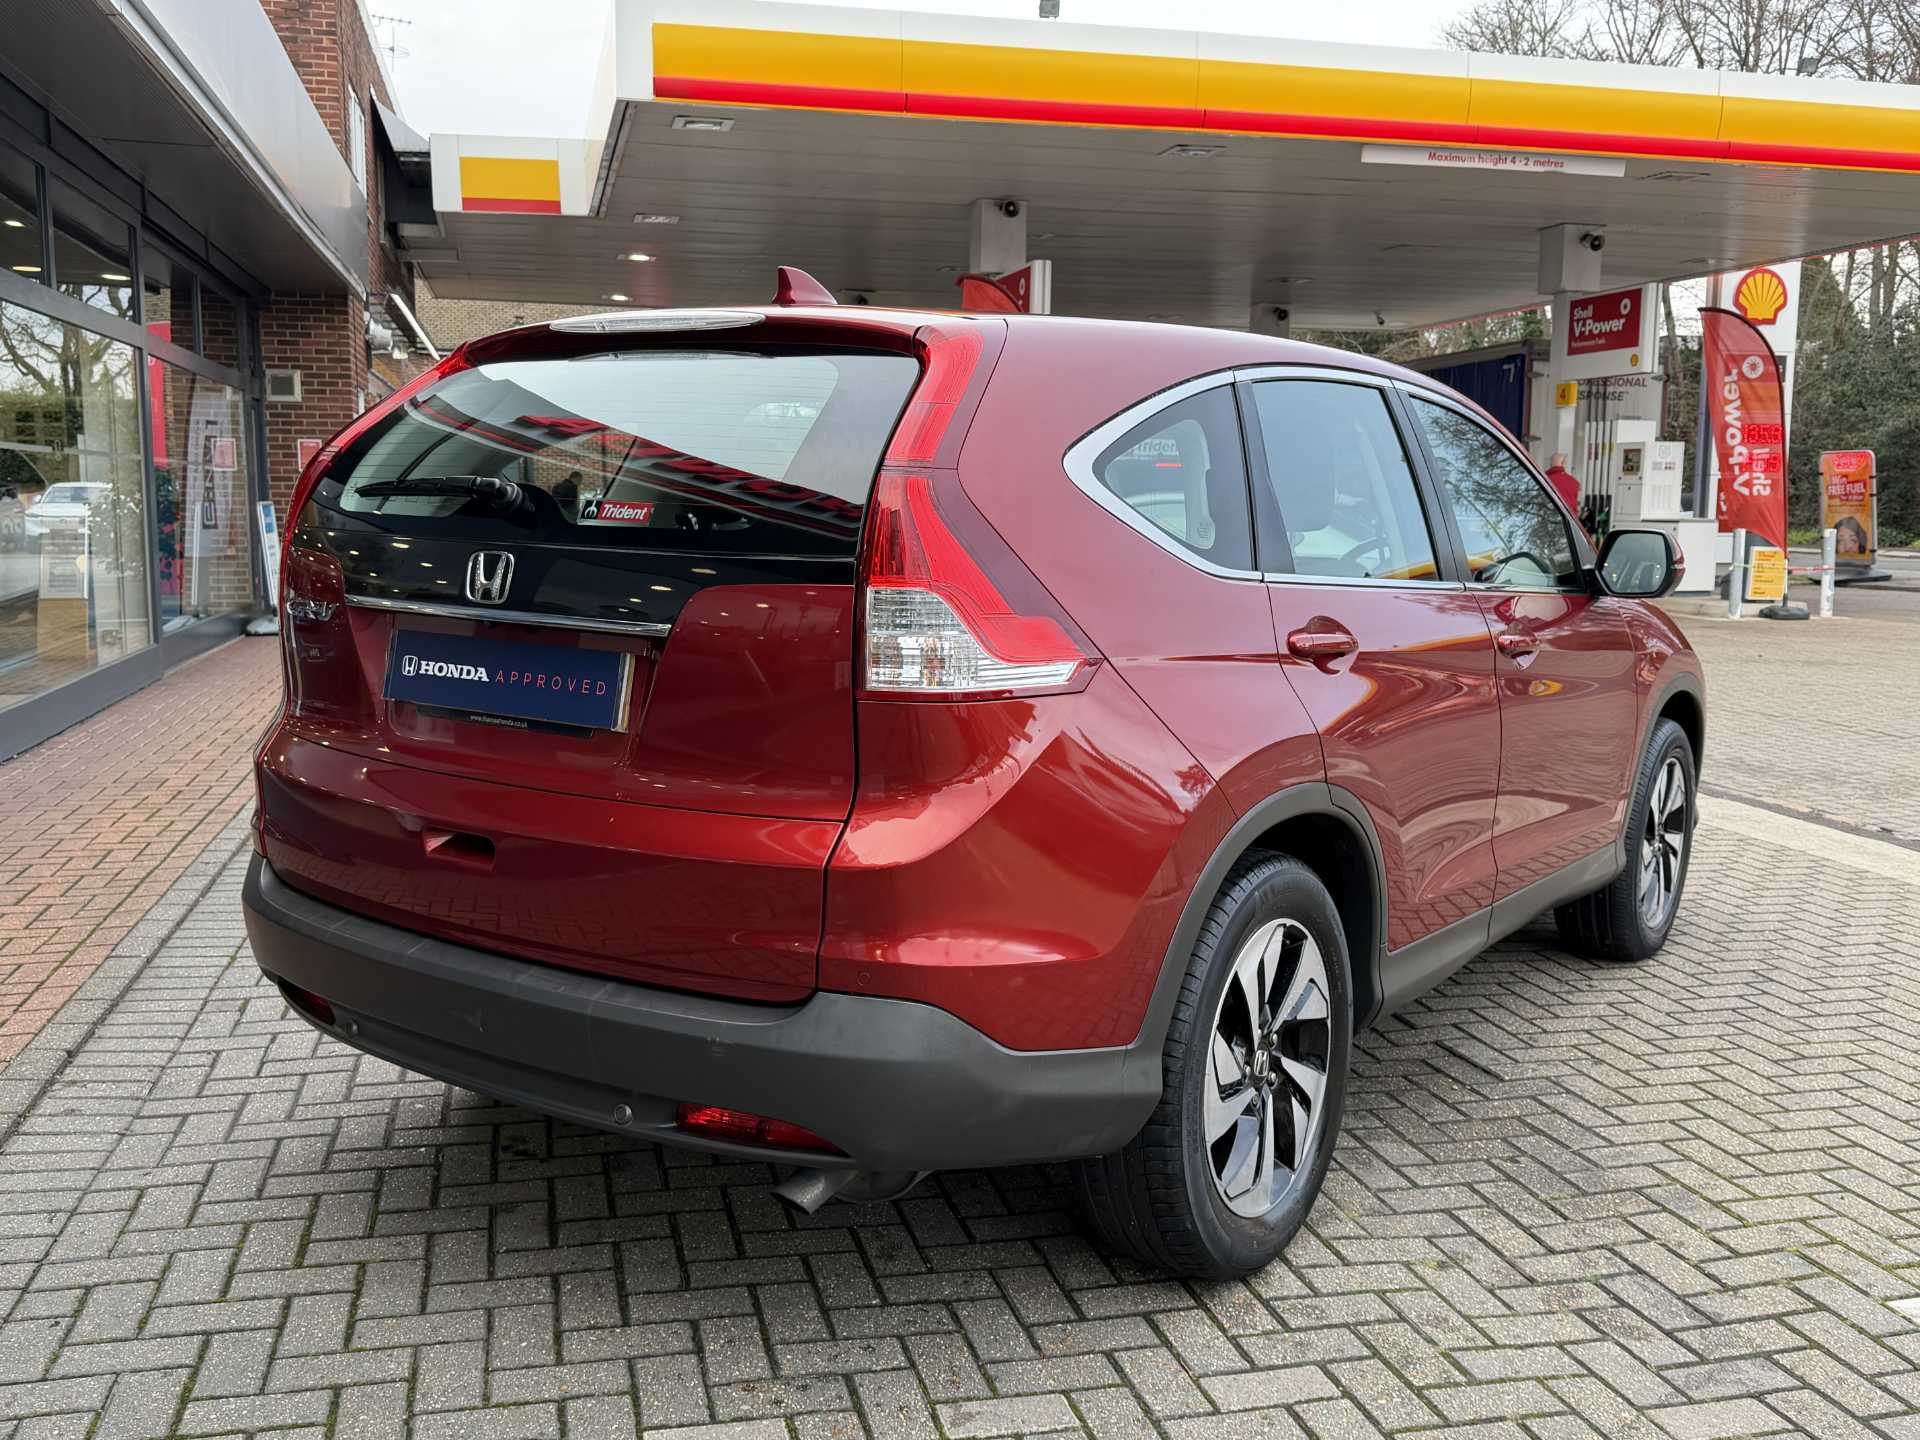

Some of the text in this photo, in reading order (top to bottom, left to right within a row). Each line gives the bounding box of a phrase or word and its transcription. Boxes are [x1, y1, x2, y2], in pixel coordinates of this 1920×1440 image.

[1427, 151, 1476, 164] Maximum
[1478, 153, 1507, 166] height
[1533, 158, 1564, 169] metres
[1573, 304, 1594, 319] Shell
[1573, 318, 1626, 337] V-Power
[1577, 375, 1648, 388] OFESSIONAL
[1827, 481, 1865, 496] FREE FUEL
[601, 504, 649, 520] Trident
[418, 660, 490, 682] HONDA
[495, 669, 607, 696] APPROVED
